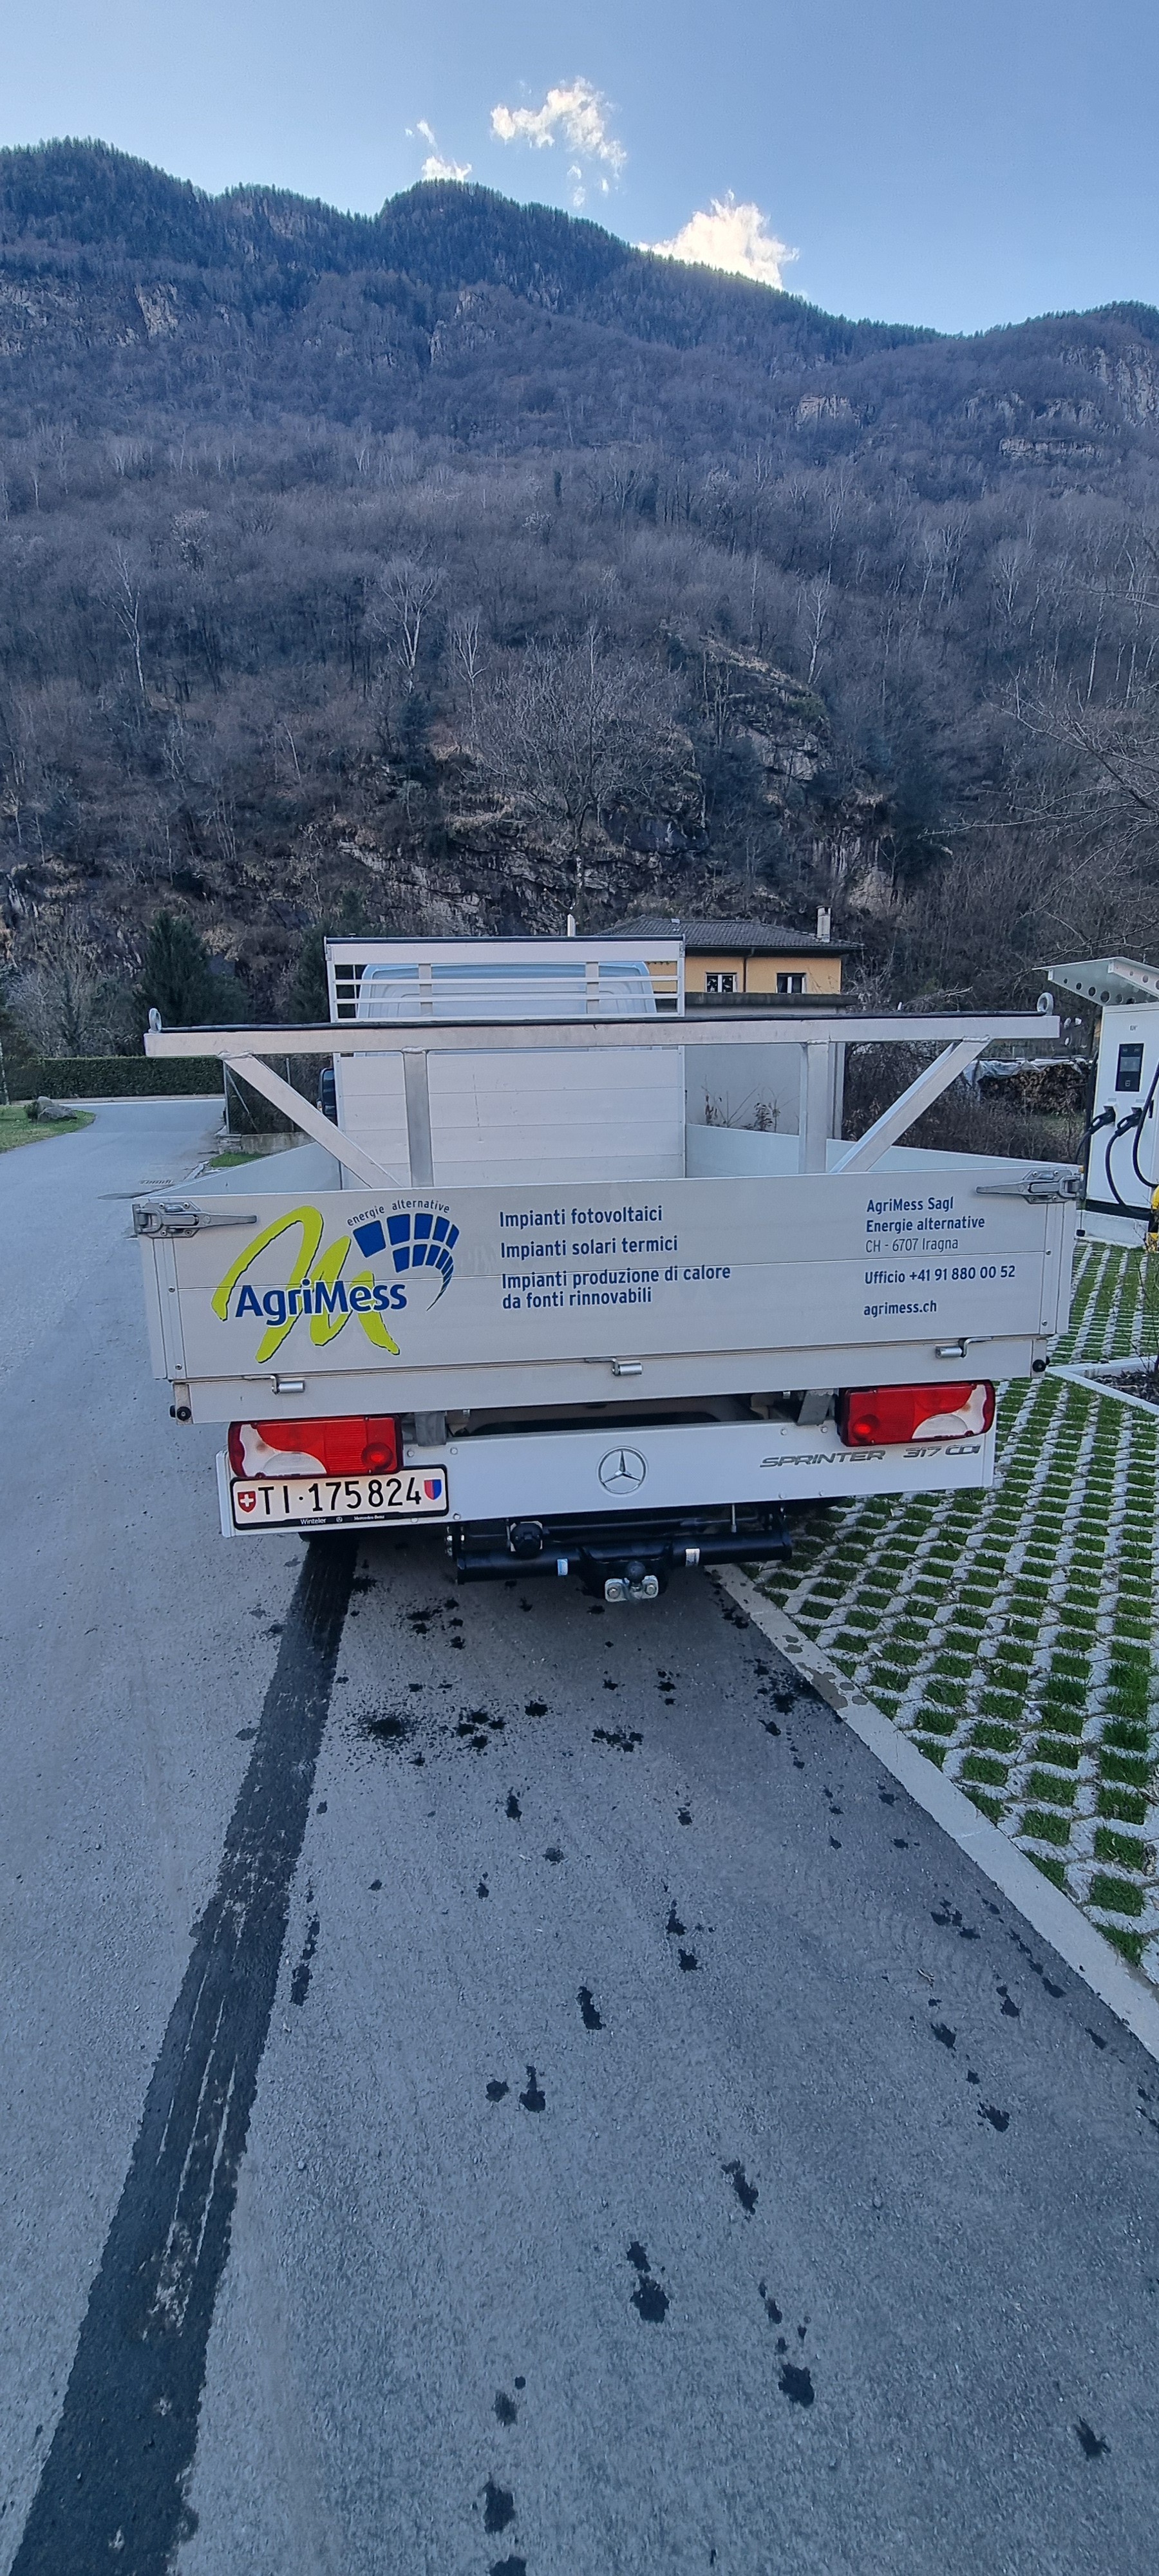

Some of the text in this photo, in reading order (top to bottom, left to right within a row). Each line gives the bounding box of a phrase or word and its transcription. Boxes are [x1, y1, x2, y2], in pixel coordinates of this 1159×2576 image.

[347, 1199, 450, 1226] energie alternative
[867, 1197, 954, 1215] AgriMess Sagl
[500, 1206, 663, 1229] Impianti fotovoltaici
[866, 1215, 985, 1234] Energie alternative
[501, 1235, 678, 1260] Impianti solari termici
[866, 1240, 881, 1253] CH
[892, 1238, 918, 1251] 6707
[922, 1238, 958, 1253] Iragna
[502, 1265, 731, 1291] Impianti produzione di calore
[865, 1265, 1015, 1285] Ufficio +41 91 880 00 52
[236, 1278, 407, 1325] AgriMess
[502, 1287, 652, 1309] da fonti rinnovabili
[863, 1300, 937, 1317] agrimess.ch
[759, 1450, 886, 1468] SPRINTER
[903, 1444, 981, 1459] 317 CDI
